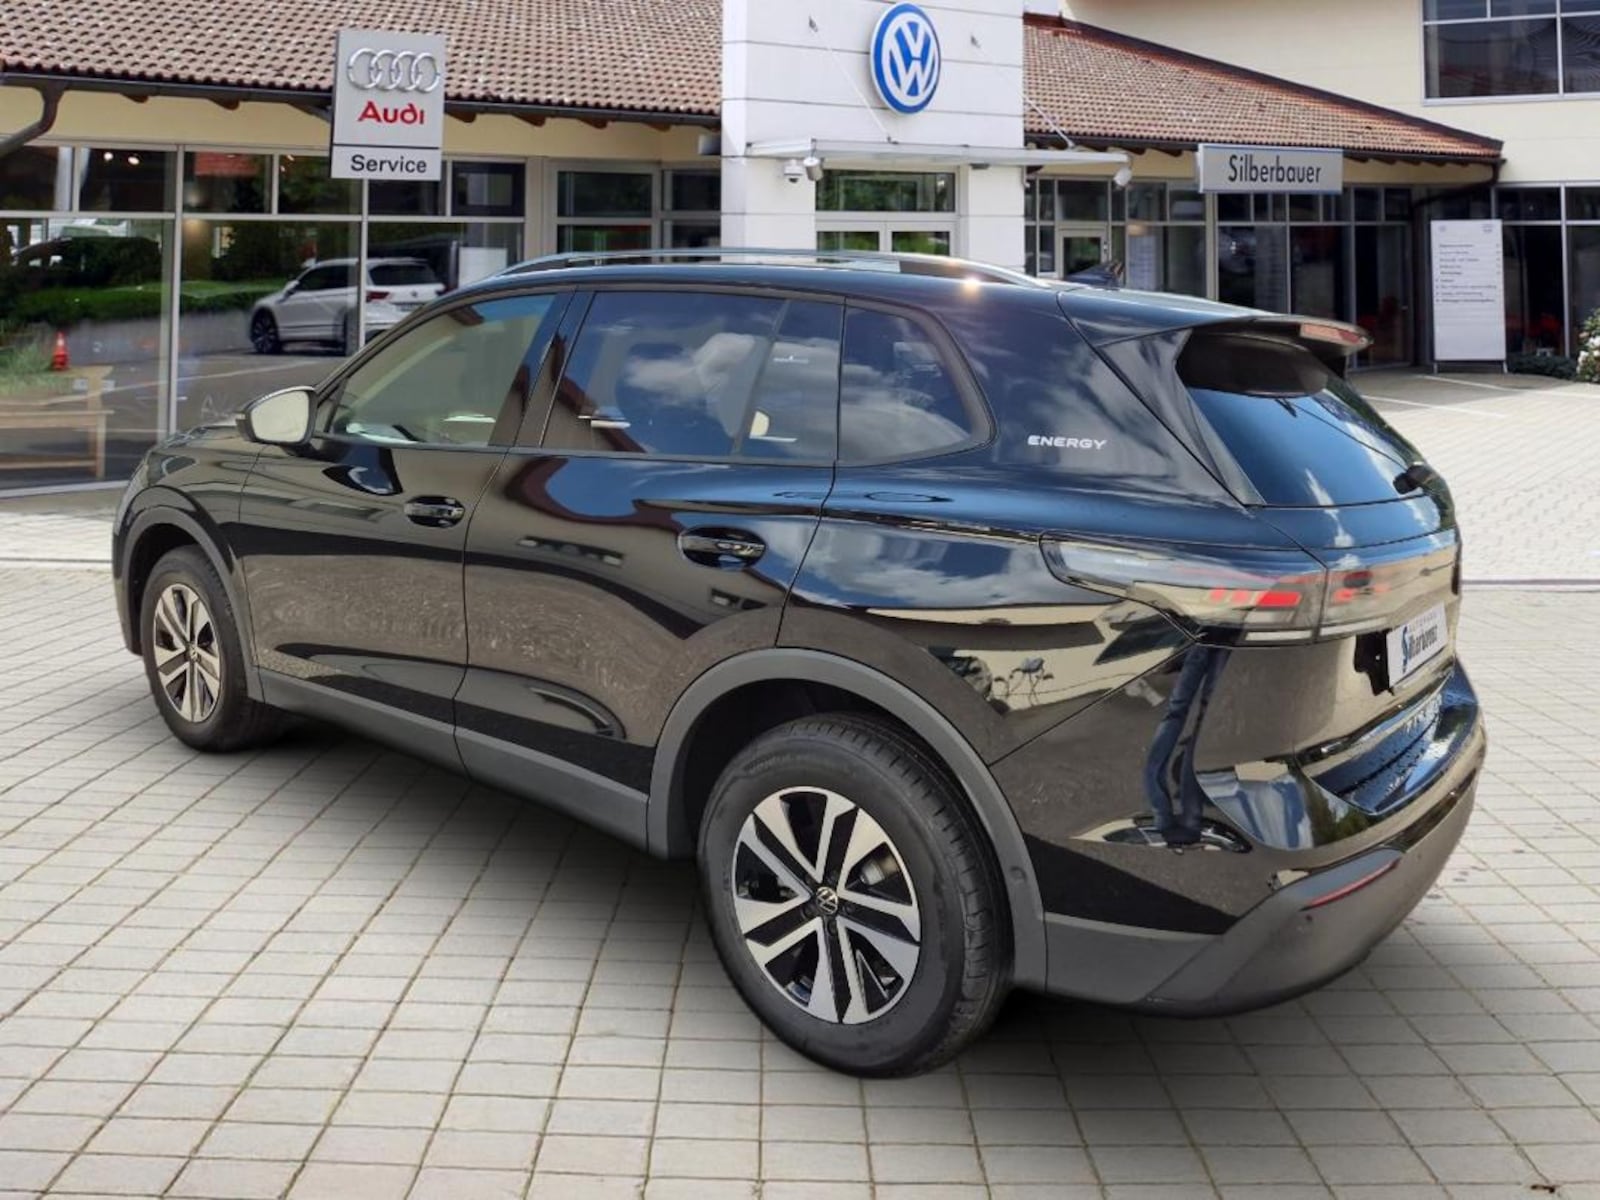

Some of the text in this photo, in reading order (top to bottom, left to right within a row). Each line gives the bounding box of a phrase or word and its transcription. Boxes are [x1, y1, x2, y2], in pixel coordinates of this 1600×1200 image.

[357, 100, 425, 126] Audi
[350, 154, 428, 174] Service
[1227, 153, 1322, 183] Silberbauer
[1027, 434, 1108, 450] ENERGY
